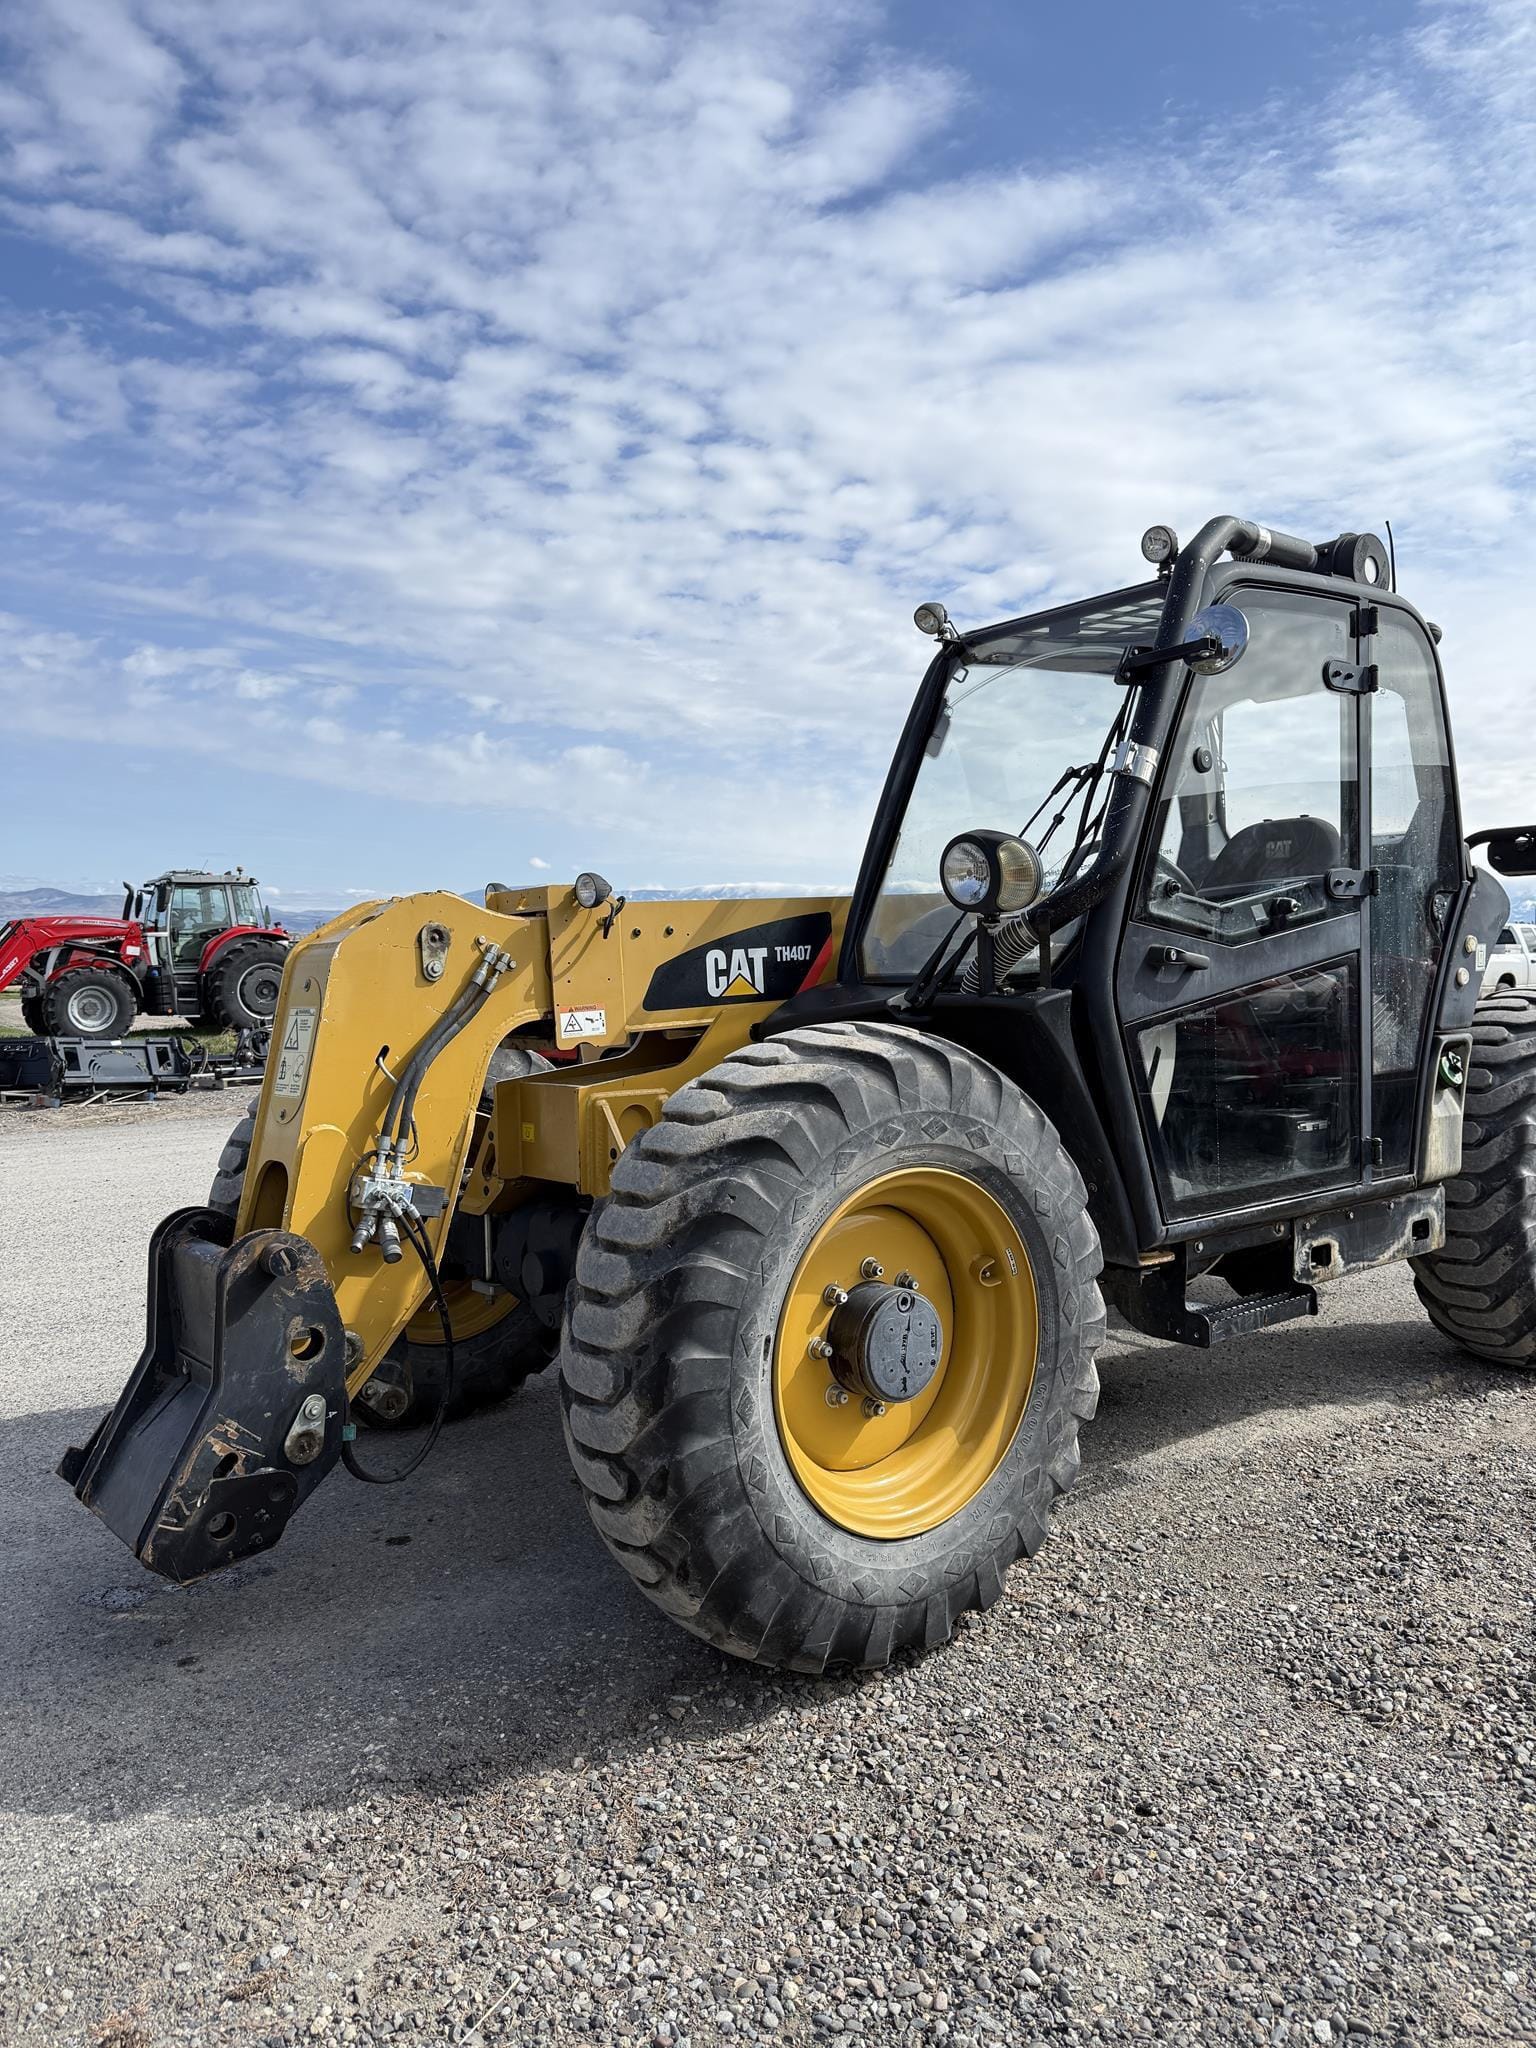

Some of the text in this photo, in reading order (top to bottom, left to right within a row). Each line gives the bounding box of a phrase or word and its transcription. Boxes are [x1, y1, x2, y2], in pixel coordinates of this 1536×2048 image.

[1265, 840, 1292, 858] CAT
[706, 945, 812, 998] CAT TH407
